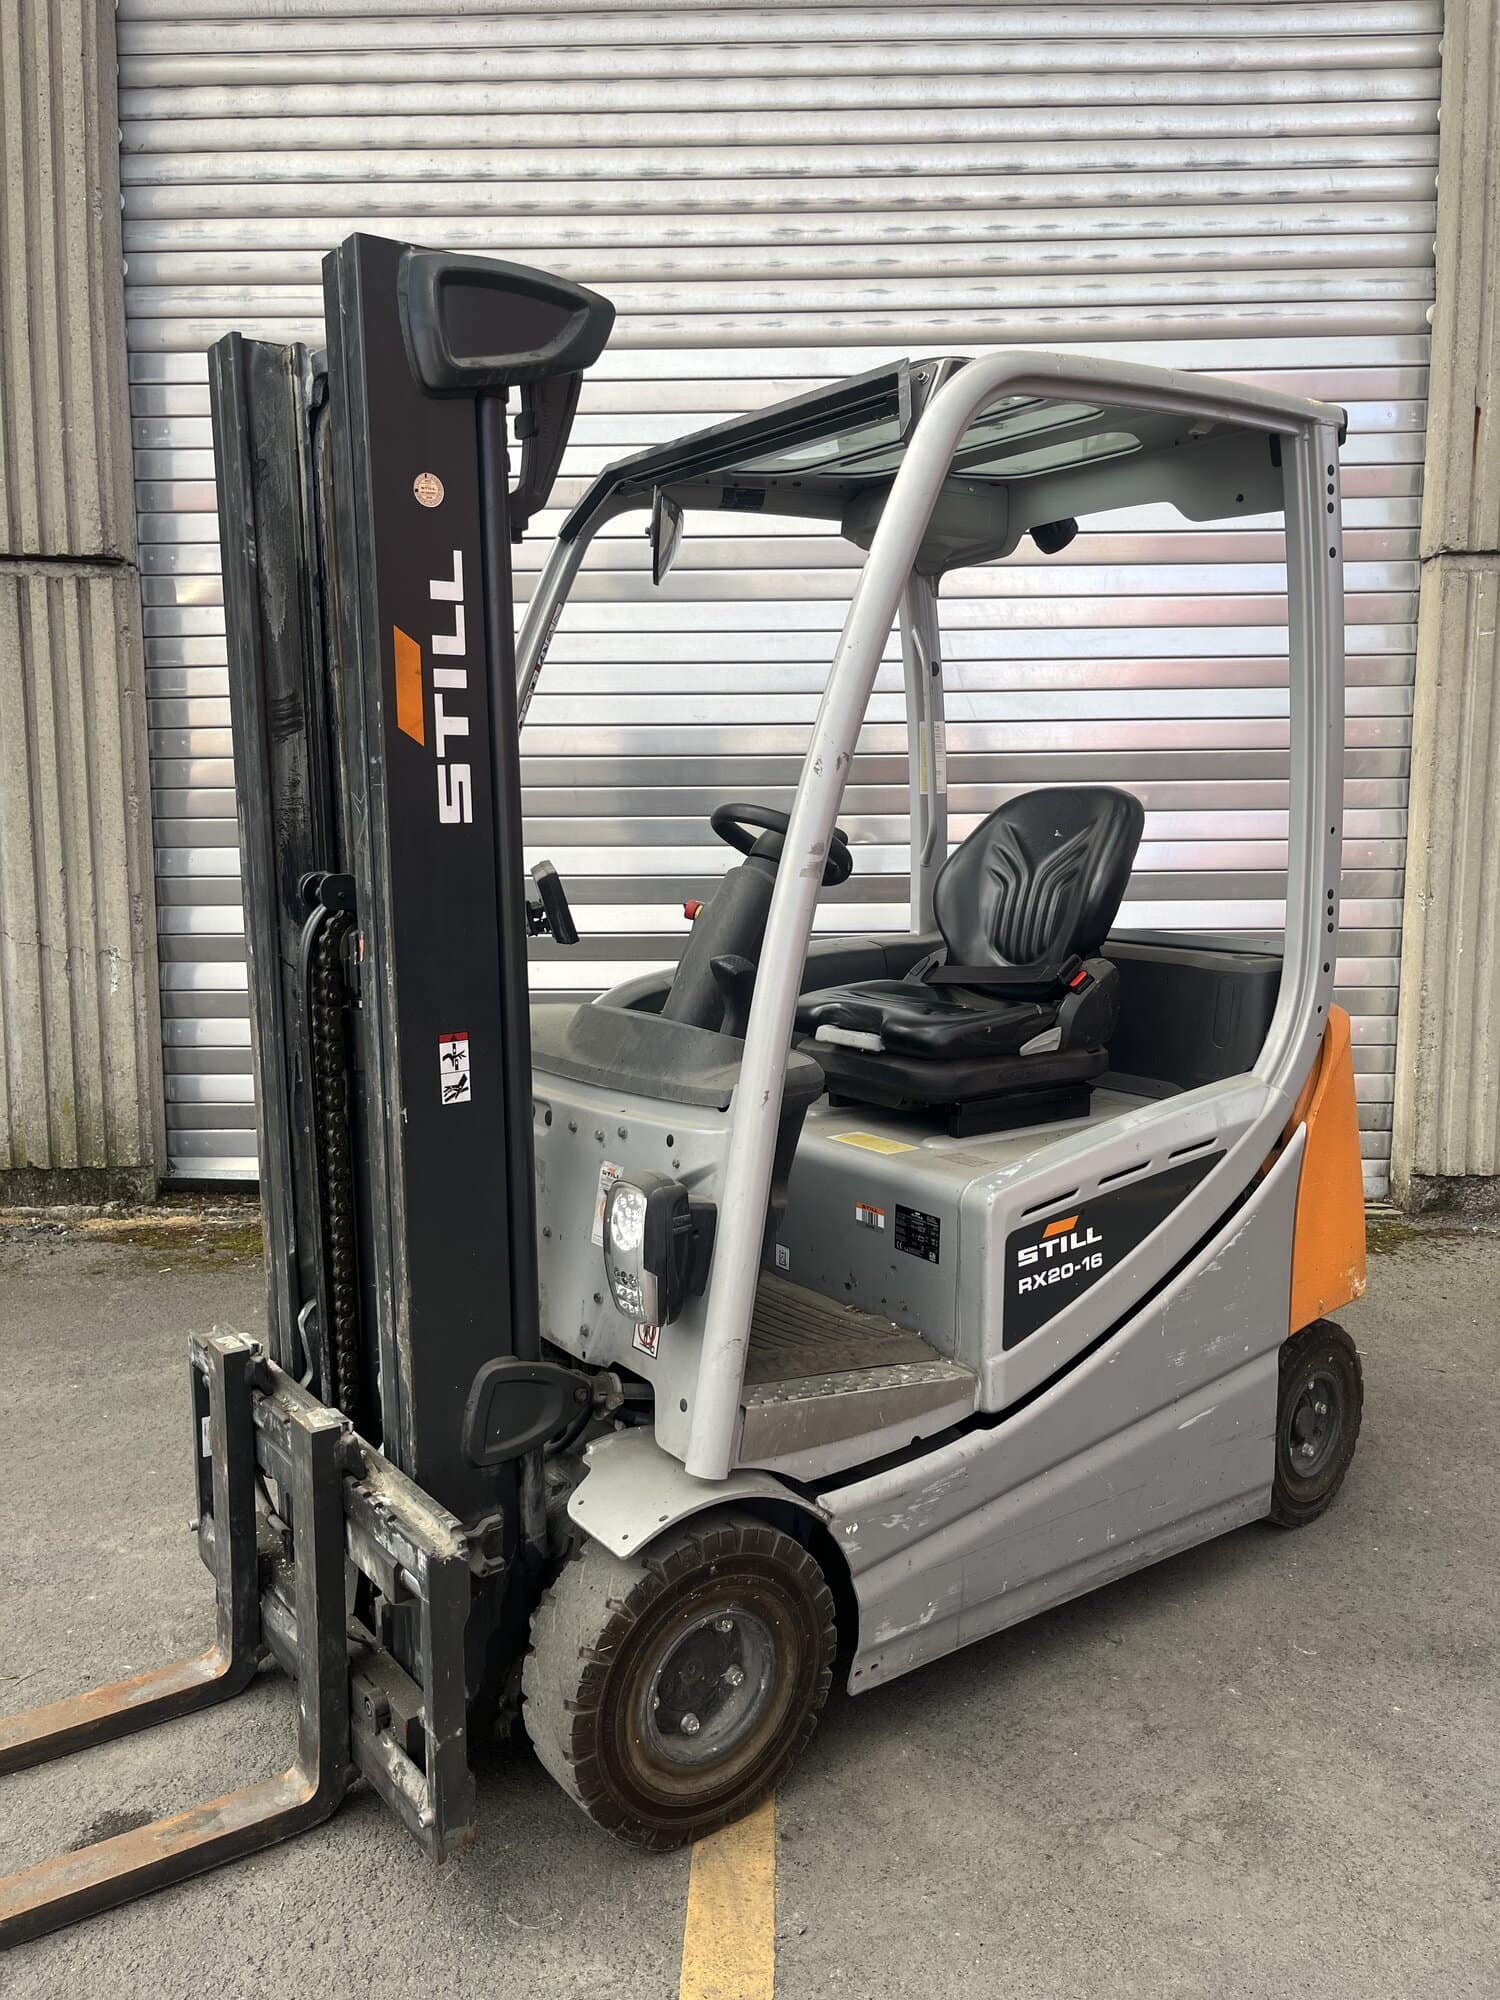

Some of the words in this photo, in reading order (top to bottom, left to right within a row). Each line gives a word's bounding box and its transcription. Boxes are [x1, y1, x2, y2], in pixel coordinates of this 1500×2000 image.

[430, 550, 473, 824] STILL
[1017, 1227, 1102, 1267] STILL
[1018, 1252, 1103, 1295] RX20-16
